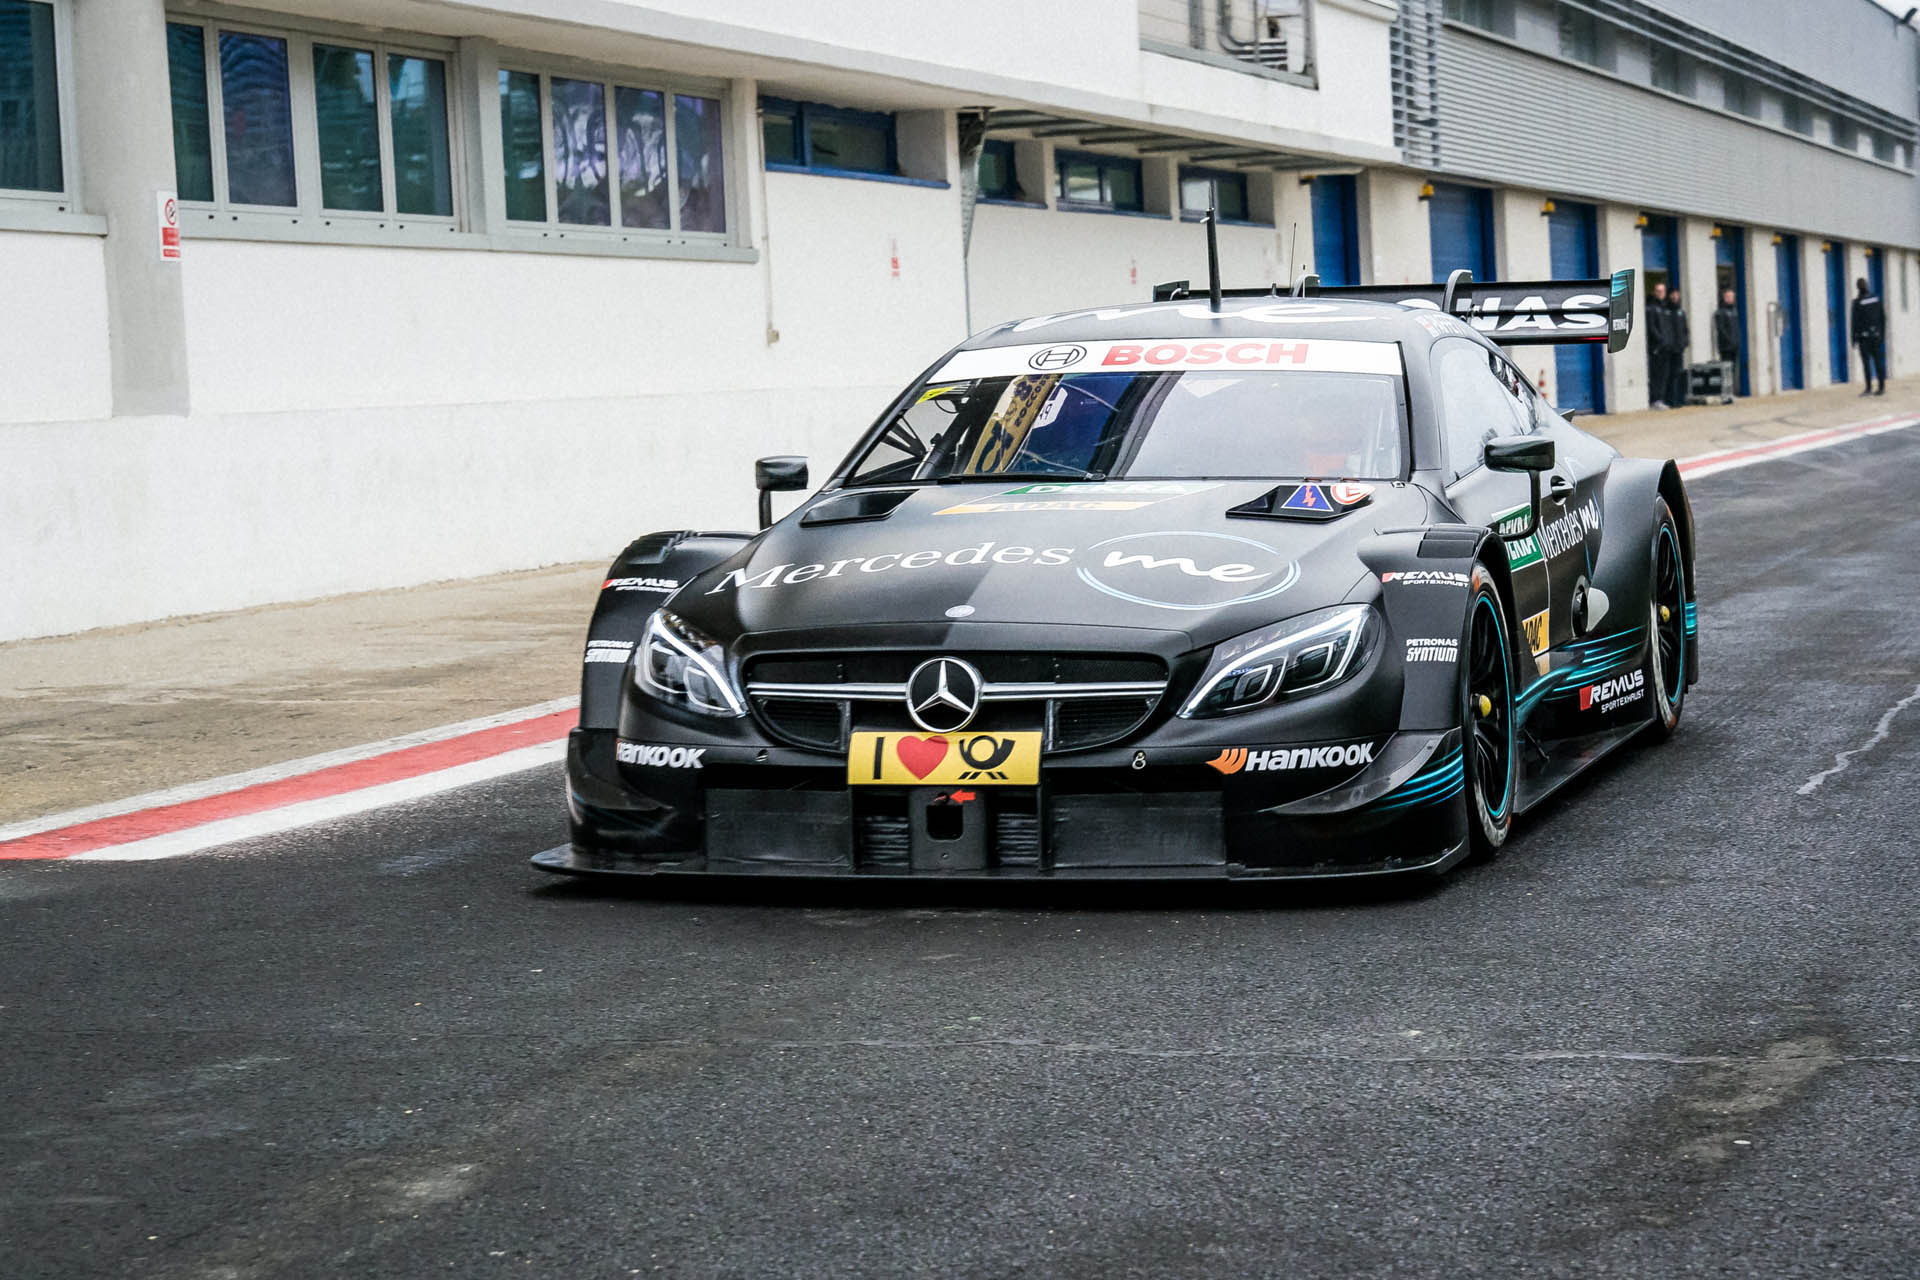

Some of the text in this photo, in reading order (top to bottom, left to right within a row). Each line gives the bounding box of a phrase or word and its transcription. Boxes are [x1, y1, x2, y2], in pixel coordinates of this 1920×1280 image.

[1100, 343, 1309, 366] BOSCH
[1536, 499, 1599, 561] Mercedes me
[705, 541, 1274, 597] Mercedes me
[1389, 571, 1469, 583] REMUS
[1402, 579, 1469, 588] SPORTEXHAUST
[1406, 638, 1458, 647] PETRONAS
[1406, 647, 1458, 663] SYNTIUM
[1589, 669, 1644, 705] REMUS
[1601, 689, 1645, 714] SPORTEXHAUST
